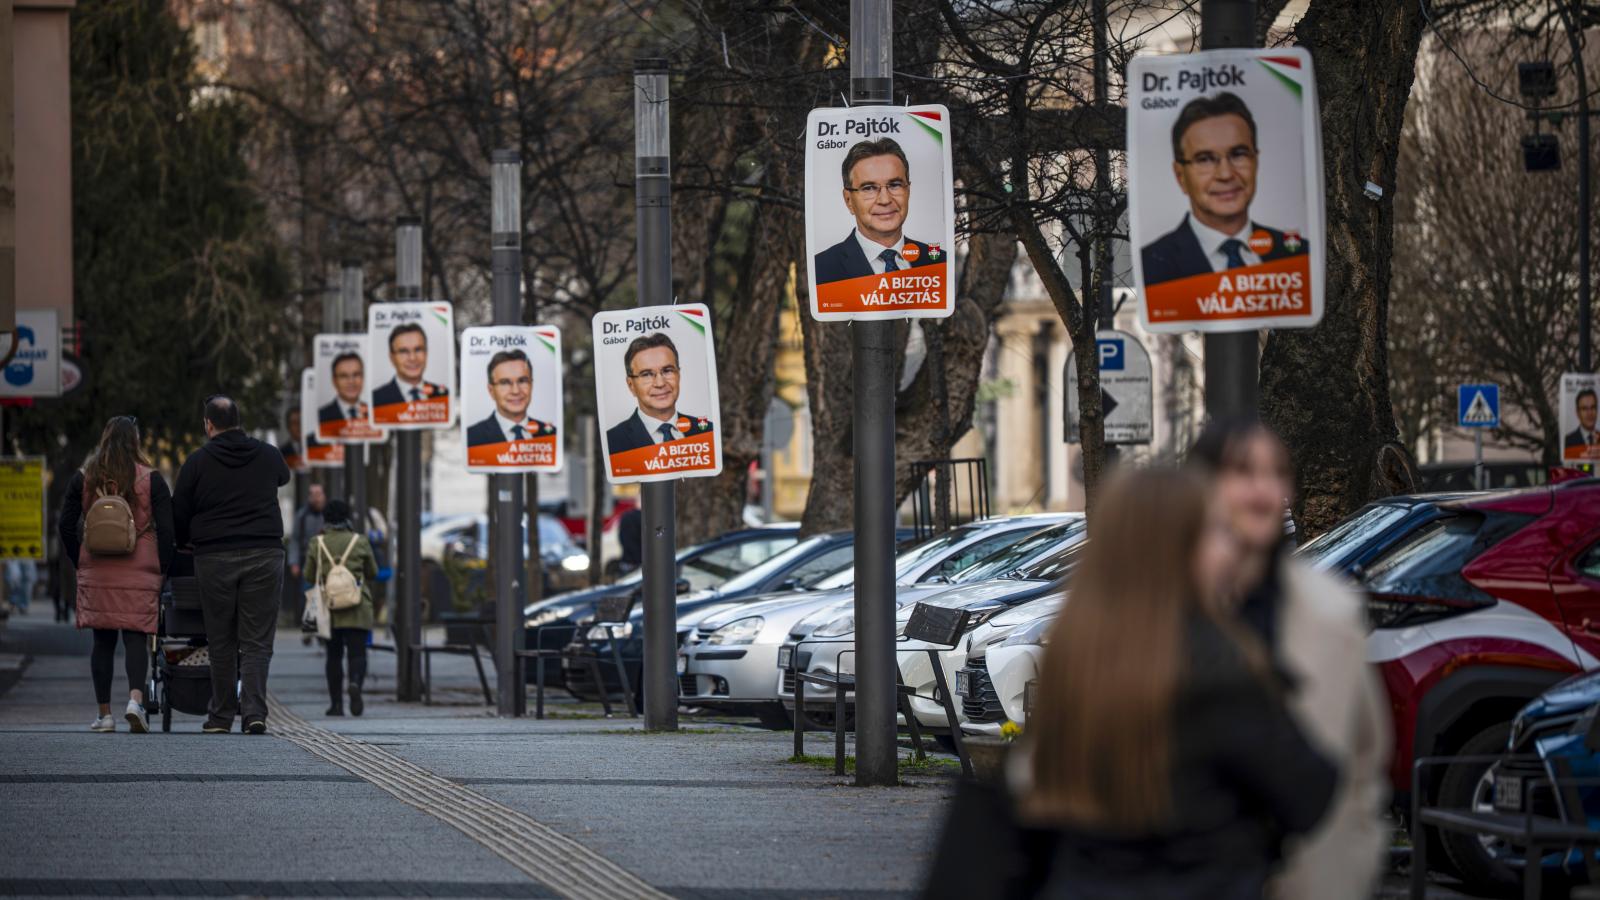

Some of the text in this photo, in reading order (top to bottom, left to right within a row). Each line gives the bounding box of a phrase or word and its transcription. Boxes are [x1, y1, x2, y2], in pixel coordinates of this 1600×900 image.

[1141, 65, 1246, 94] Dr. Pajtók
[1141, 98, 1179, 111] Gábor
[818, 117, 900, 137] Dr. Pajtók
[817, 140, 847, 150] Gábor
[878, 276, 941, 290] A BIZTOS
[1218, 272, 1303, 293] A BIZTOS
[860, 291, 941, 306] VÁLASZTÁS
[1197, 292, 1304, 315] VÁLASZTÁS
[603, 316, 671, 334] Dr. Pajtók
[470, 334, 527, 348] Dr. Pajtók
[603, 337, 628, 346] Gábor
[1099, 343, 1118, 367] P
[509, 443, 518, 452] A
[659, 442, 710, 457] A BIZTOS
[497, 451, 553, 464] VÁLASZTÁS
[644, 454, 711, 471] VÁLASZTÁS
